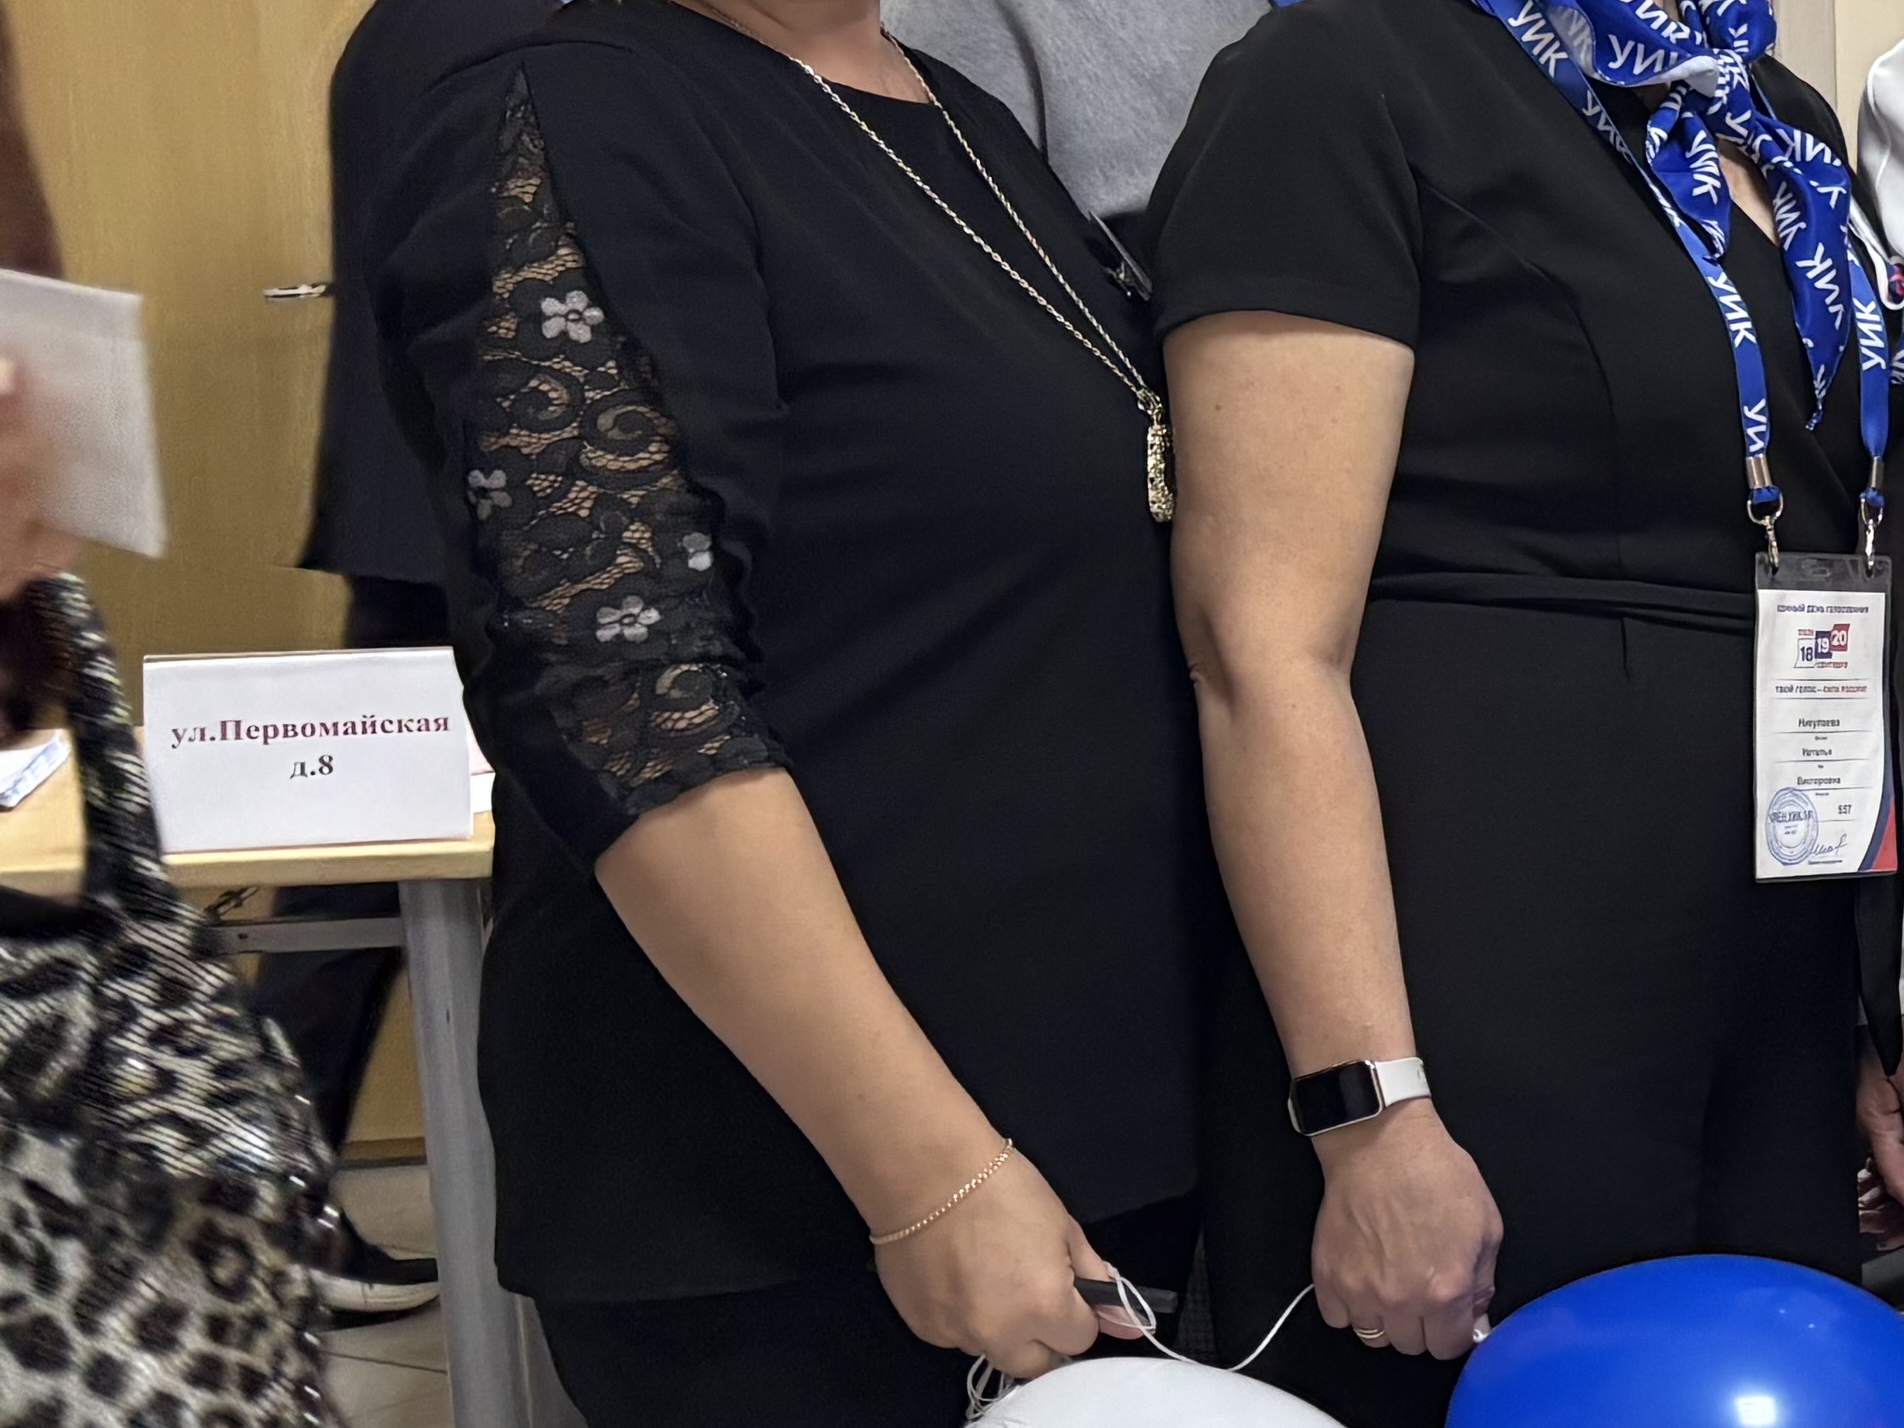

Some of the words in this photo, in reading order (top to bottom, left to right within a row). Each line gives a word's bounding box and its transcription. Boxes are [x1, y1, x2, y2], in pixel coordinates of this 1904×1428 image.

[1707, 271, 1757, 348] УИК
[1853, 297, 1887, 372] УИК
[1817, 637, 1829, 653] 19
[1831, 630, 1847, 646] 20
[1800, 646, 1813, 662] 18
[171, 714, 450, 749] ул.Первомайская
[290, 754, 334, 779] д.8
